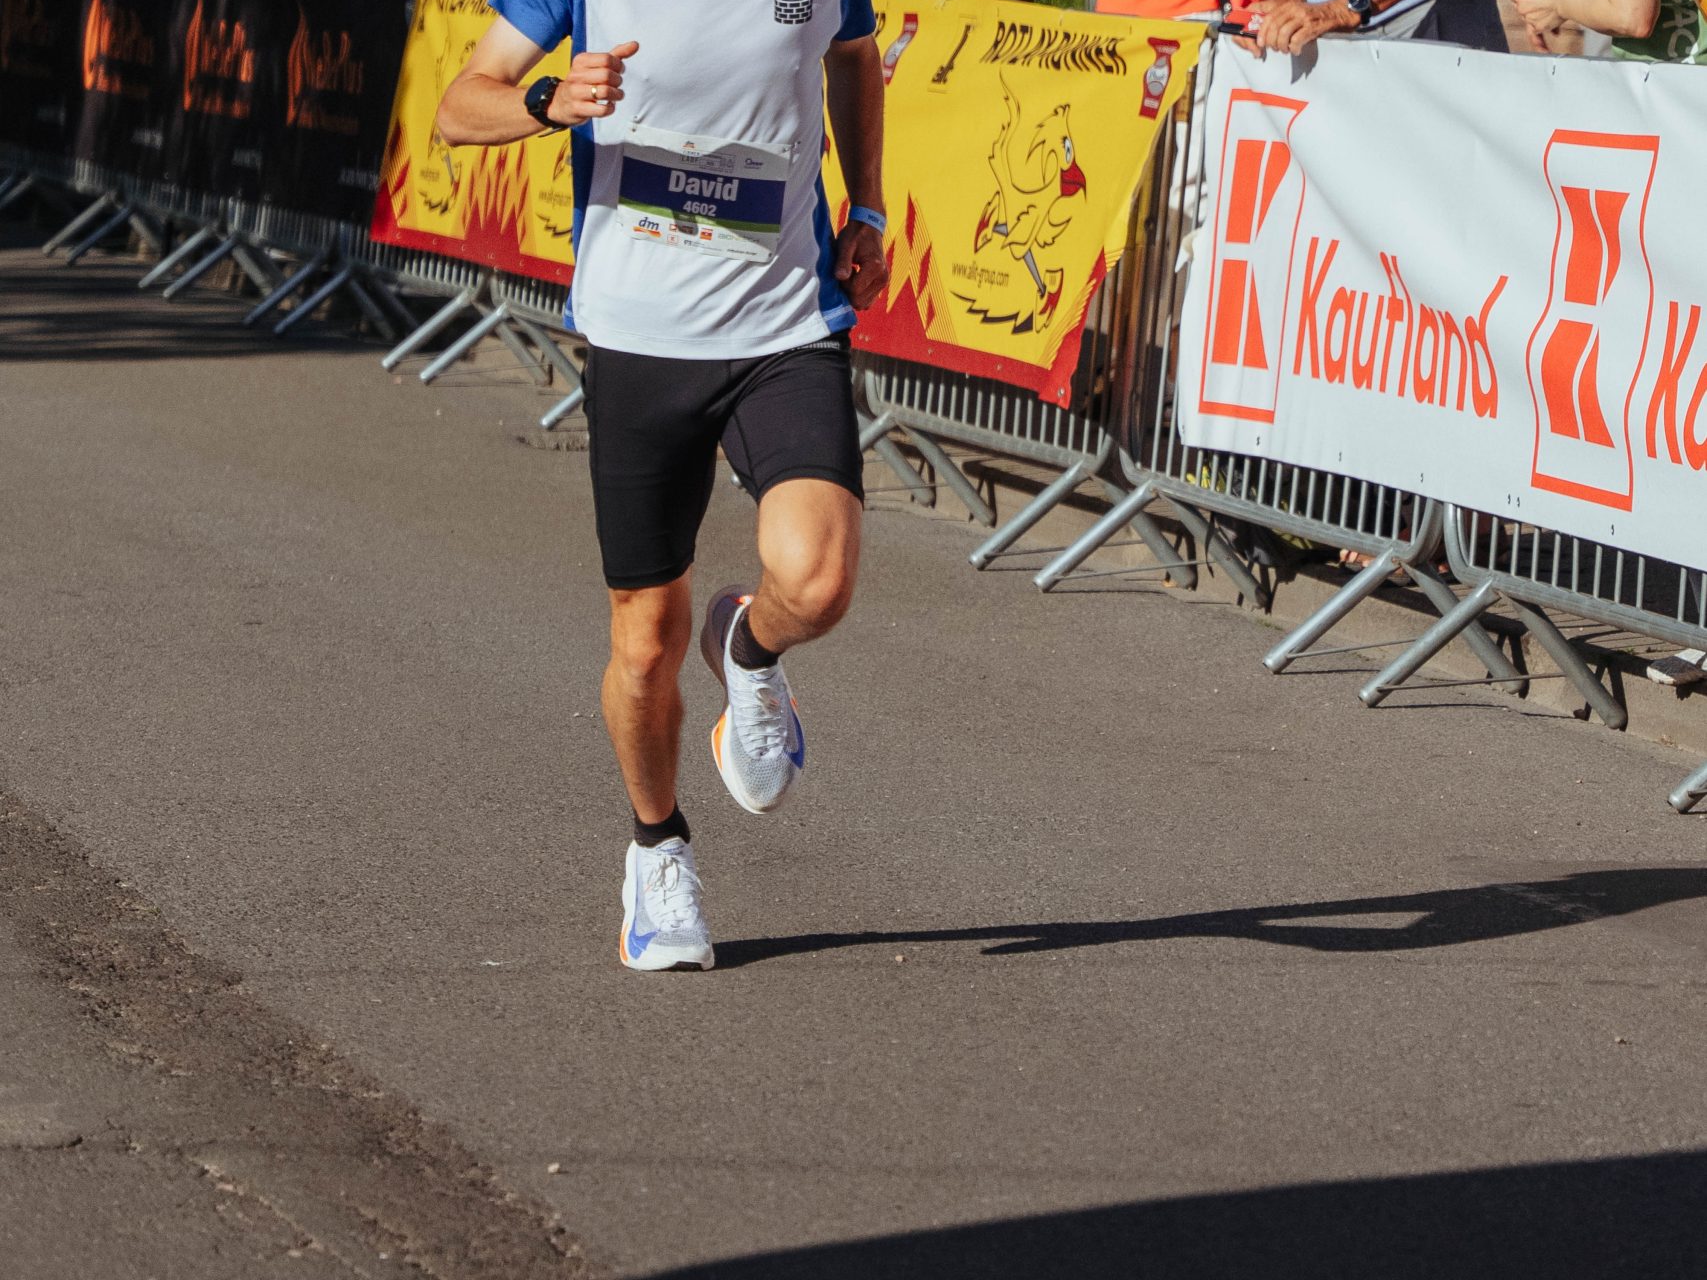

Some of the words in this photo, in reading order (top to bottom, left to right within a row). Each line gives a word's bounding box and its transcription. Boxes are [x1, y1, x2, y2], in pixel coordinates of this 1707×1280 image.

[668, 170, 739, 201] David
[682, 200, 717, 217] 4602
[638, 216, 660, 231] dm
[1293, 236, 1509, 420] Kaufland
